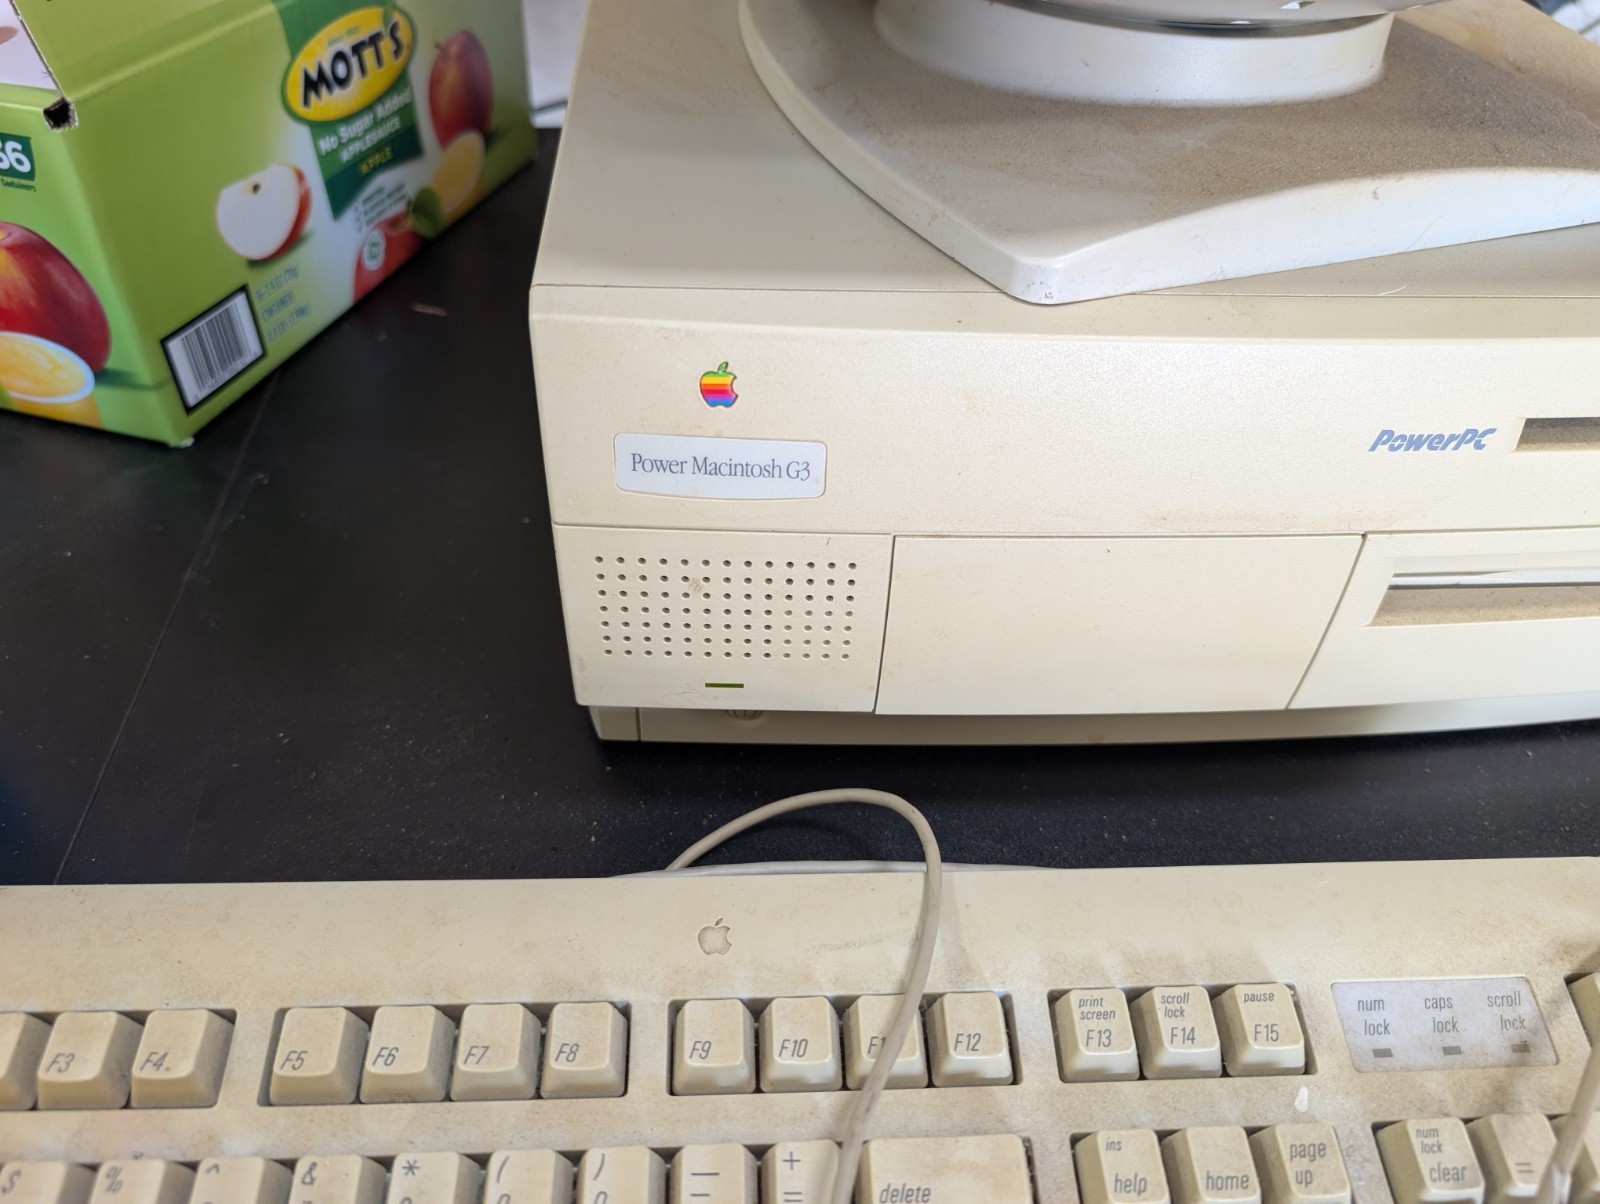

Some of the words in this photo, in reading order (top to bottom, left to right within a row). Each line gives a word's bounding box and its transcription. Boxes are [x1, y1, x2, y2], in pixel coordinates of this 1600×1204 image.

[319, 135, 339, 156] No
[339, 112, 374, 143] Sugar
[375, 85, 413, 119] Added
[341, 115, 401, 164] APPLESAUCE
[360, 145, 392, 175] APPLE
[1367, 428, 1497, 452] PowerPC
[631, 452, 688, 475] Power
[692, 455, 782, 479] Macintosh
[786, 461, 811, 482] G3
[1078, 996, 1104, 1009] print
[1160, 992, 1190, 1005] scroll
[1243, 992, 1275, 1003] pause
[1357, 999, 1385, 1012] num
[1424, 996, 1453, 1012] caps
[1487, 990, 1522, 1008] scroll
[1080, 1009, 1116, 1020] screen
[1164, 1006, 1185, 1018] lock
[1364, 1018, 1391, 1036] lock
[1432, 1017, 1459, 1033] lock
[1500, 1014, 1527, 1031] lock
[1085, 1028, 1112, 1048] F13
[1170, 1026, 1196, 1045] F14
[1254, 1023, 1280, 1042] F15
[689, 1040, 712, 1060] F9
[778, 1038, 808, 1058] F10
[953, 1033, 981, 1052] F12
[139, 1052, 169, 1071] F4
[280, 1051, 308, 1071] F5
[372, 1047, 399, 1067] F6
[463, 1045, 490, 1065] F7
[554, 1043, 580, 1063] F8
[46, 1053, 75, 1073] F3
[1416, 1127, 1440, 1140] num
[1105, 1138, 1123, 1152] ins
[1289, 1142, 1327, 1162] page
[1420, 1140, 1444, 1155] lock
[301, 1161, 318, 1186] &
[1206, 1170, 1250, 1192] home
[1295, 1170, 1313, 1188] up
[1429, 1161, 1467, 1183] clear
[879, 1182, 932, 1204] delete
[1114, 1172, 1148, 1197] help
